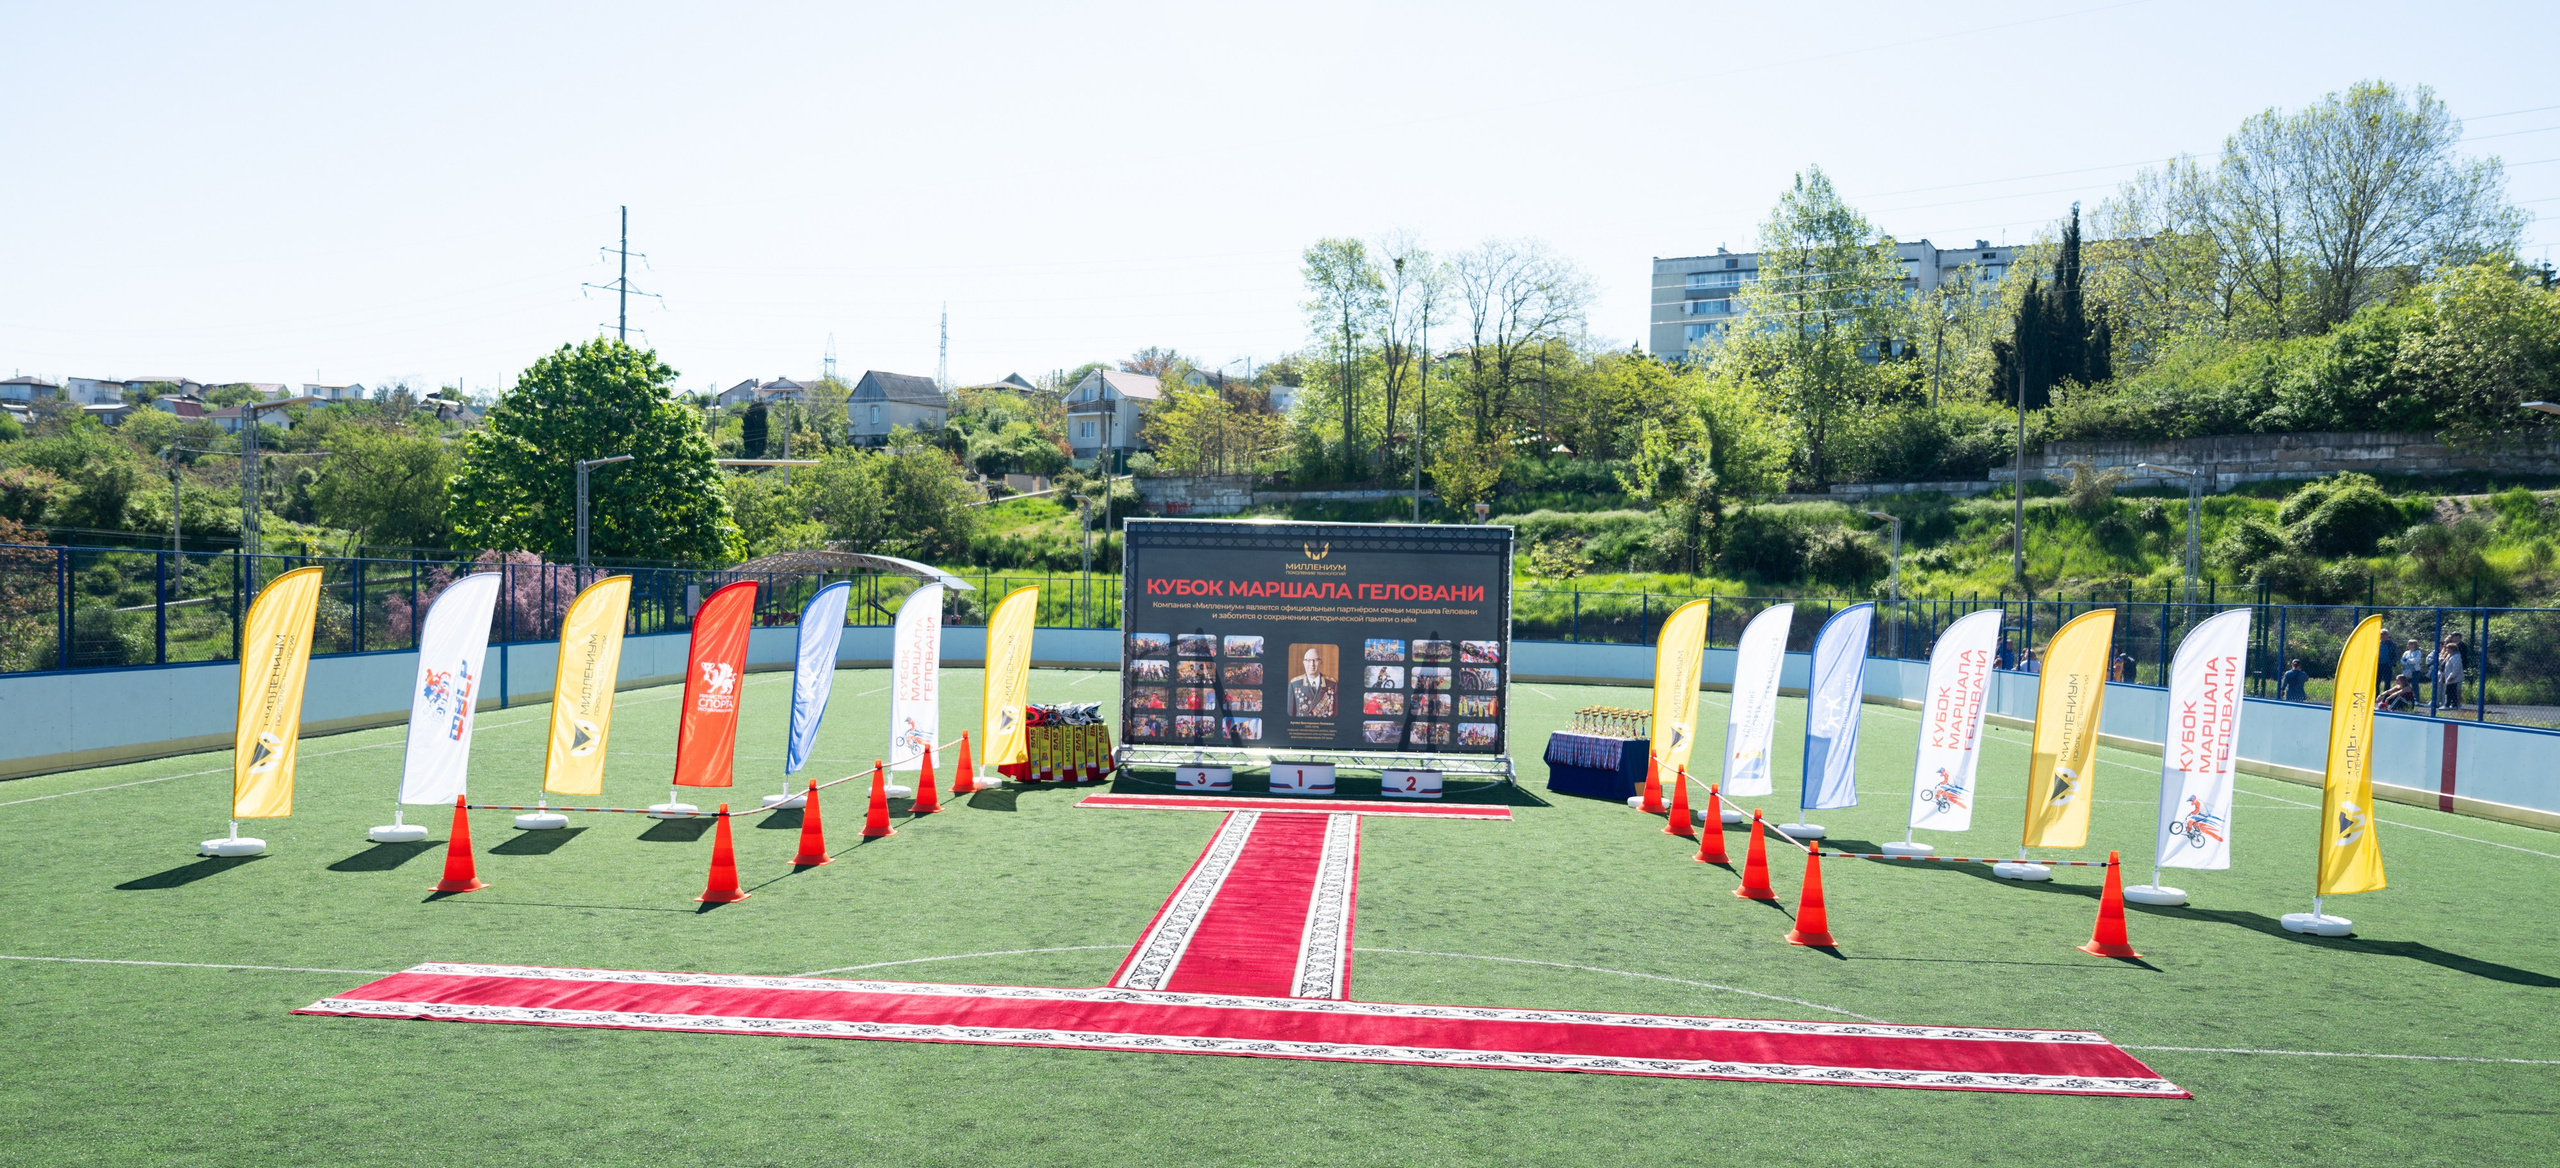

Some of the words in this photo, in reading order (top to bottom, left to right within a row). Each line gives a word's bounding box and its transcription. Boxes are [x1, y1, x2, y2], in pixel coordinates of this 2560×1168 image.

[1147, 578, 1224, 596] КУБОК
[1229, 580, 1352, 599] МАРШАЛА
[1358, 583, 1485, 602] ГЕЛОВАНИ
[1286, 563, 1346, 571] МИЛЛЕНИУМ
[1153, 601, 1191, 609] Компания
[1192, 602, 1245, 611] «Миллениум»
[1280, 604, 1335, 612] официальным
[1336, 606, 1379, 614] партнёром
[1218, 612, 1256, 620] заботится
[580, 633, 598, 716] МИЛЛЕНИУМ
[900, 649, 910, 701] КУБОК
[911, 617, 924, 701] МАРШАЛА
[924, 616, 935, 702] ГЕЛОВАНИ
[1673, 650, 1684, 719] МИЛЛЕНИУМ
[698, 698, 733, 708] СПОРТА
[1932, 686, 1951, 748] КУБОК
[1949, 649, 1972, 750] МАРШАЛА
[1965, 650, 1988, 751] ГЕЛОВАНИ
[2060, 673, 2079, 762] МИЛЛЕНИУМ
[2199, 656, 2219, 774] МАРШАЛА
[2216, 656, 2238, 774] ГЕЛОВАНИ
[2179, 700, 2197, 772] КУБОК
[1197, 772, 1206, 785] 3
[1296, 770, 1303, 787] 1
[1406, 776, 1416, 791] 2
